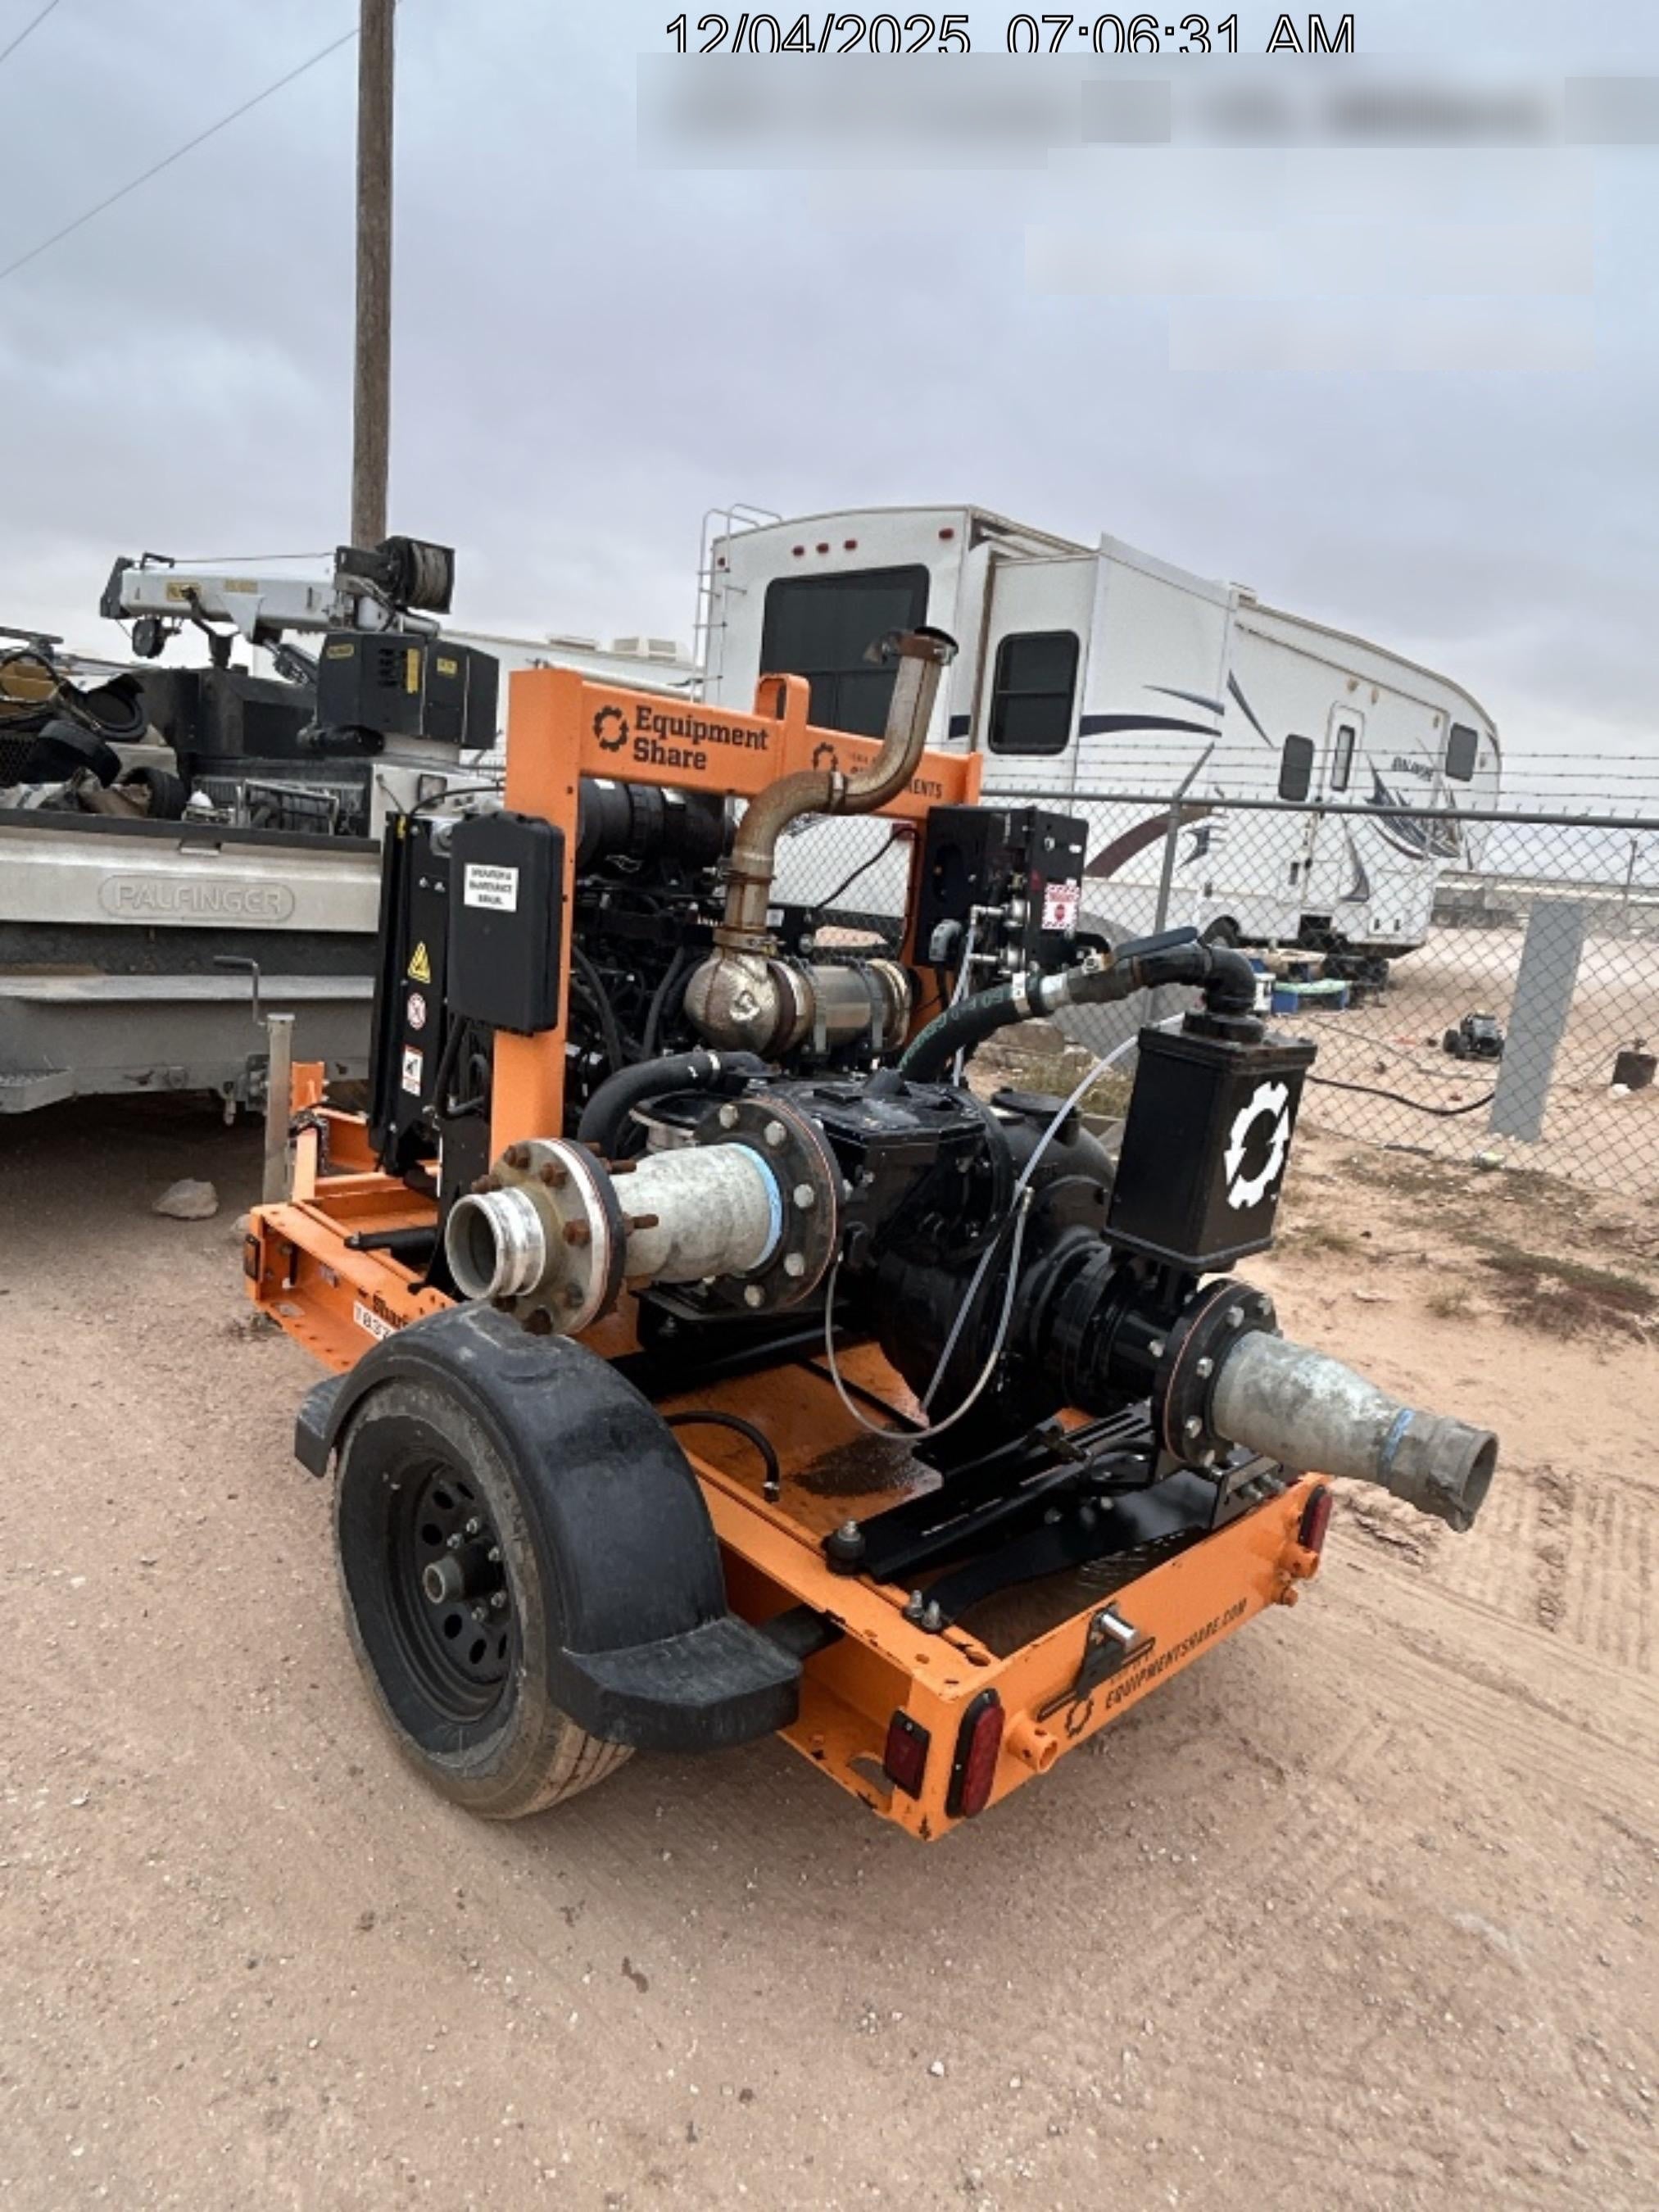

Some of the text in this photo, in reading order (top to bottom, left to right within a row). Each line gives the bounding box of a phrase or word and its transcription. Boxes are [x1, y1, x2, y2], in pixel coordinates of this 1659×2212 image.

[637, 705, 768, 750] Equipment
[633, 737, 706, 770] Share
[116, 883, 280, 914] PALFINGER
[1106, 1598, 1247, 1710] EQUIPMENTSHARE.COM
